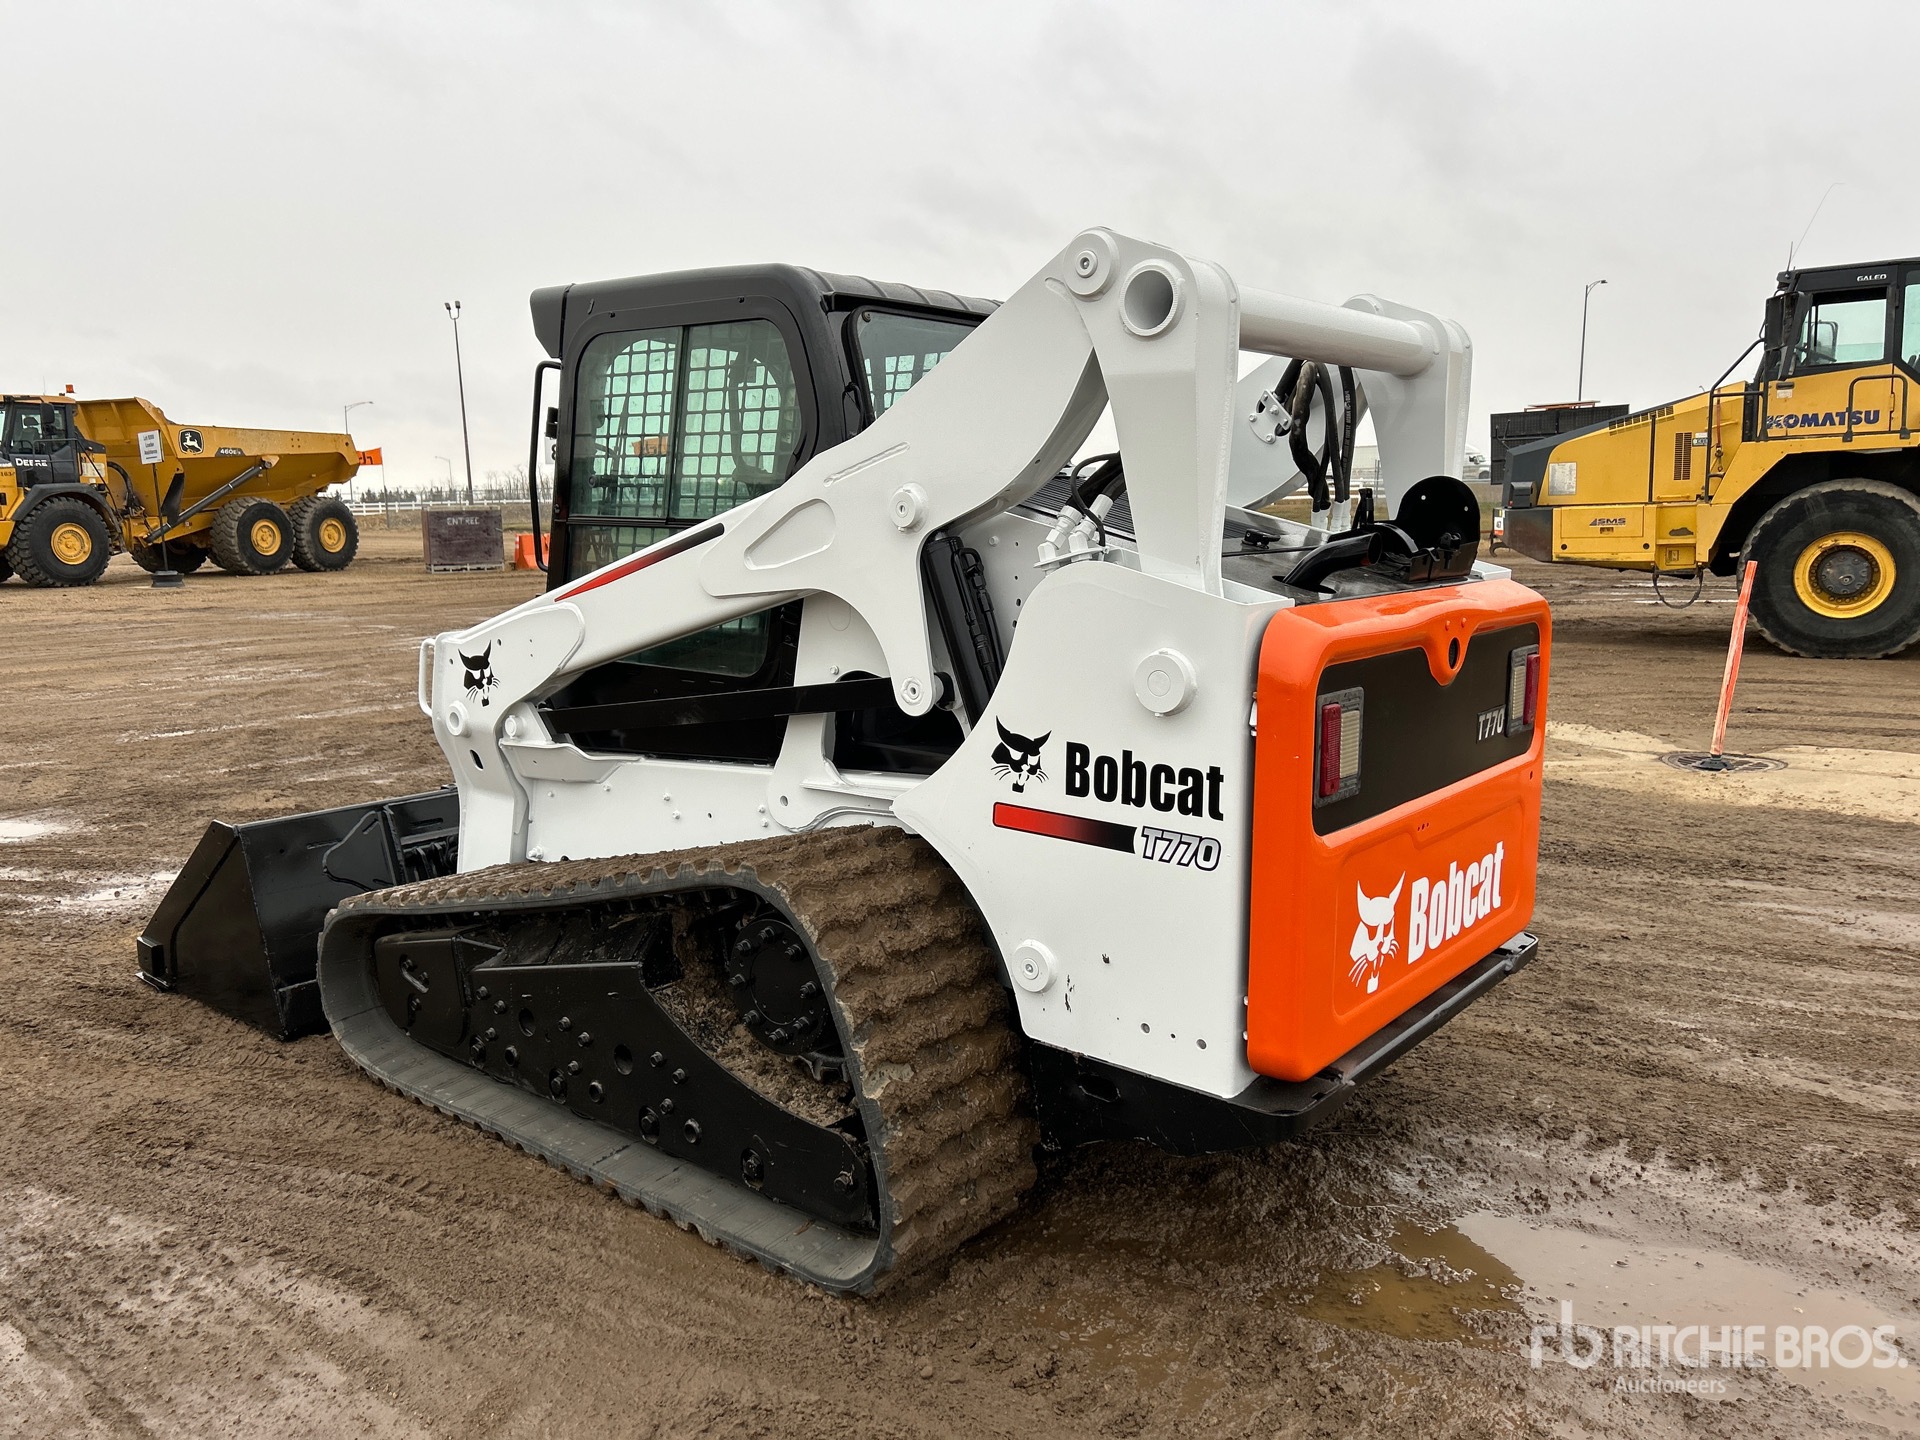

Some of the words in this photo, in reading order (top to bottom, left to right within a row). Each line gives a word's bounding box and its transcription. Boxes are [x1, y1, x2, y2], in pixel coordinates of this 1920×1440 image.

[1766, 410, 1880, 429] KOMATSU
[15, 457, 48, 467] DEERE
[1597, 517, 1626, 525] SMS
[1478, 707, 1505, 741] T770
[1065, 741, 1224, 821] Bobcat
[1141, 825, 1222, 872] T770
[1407, 840, 1504, 965] Bobcat
